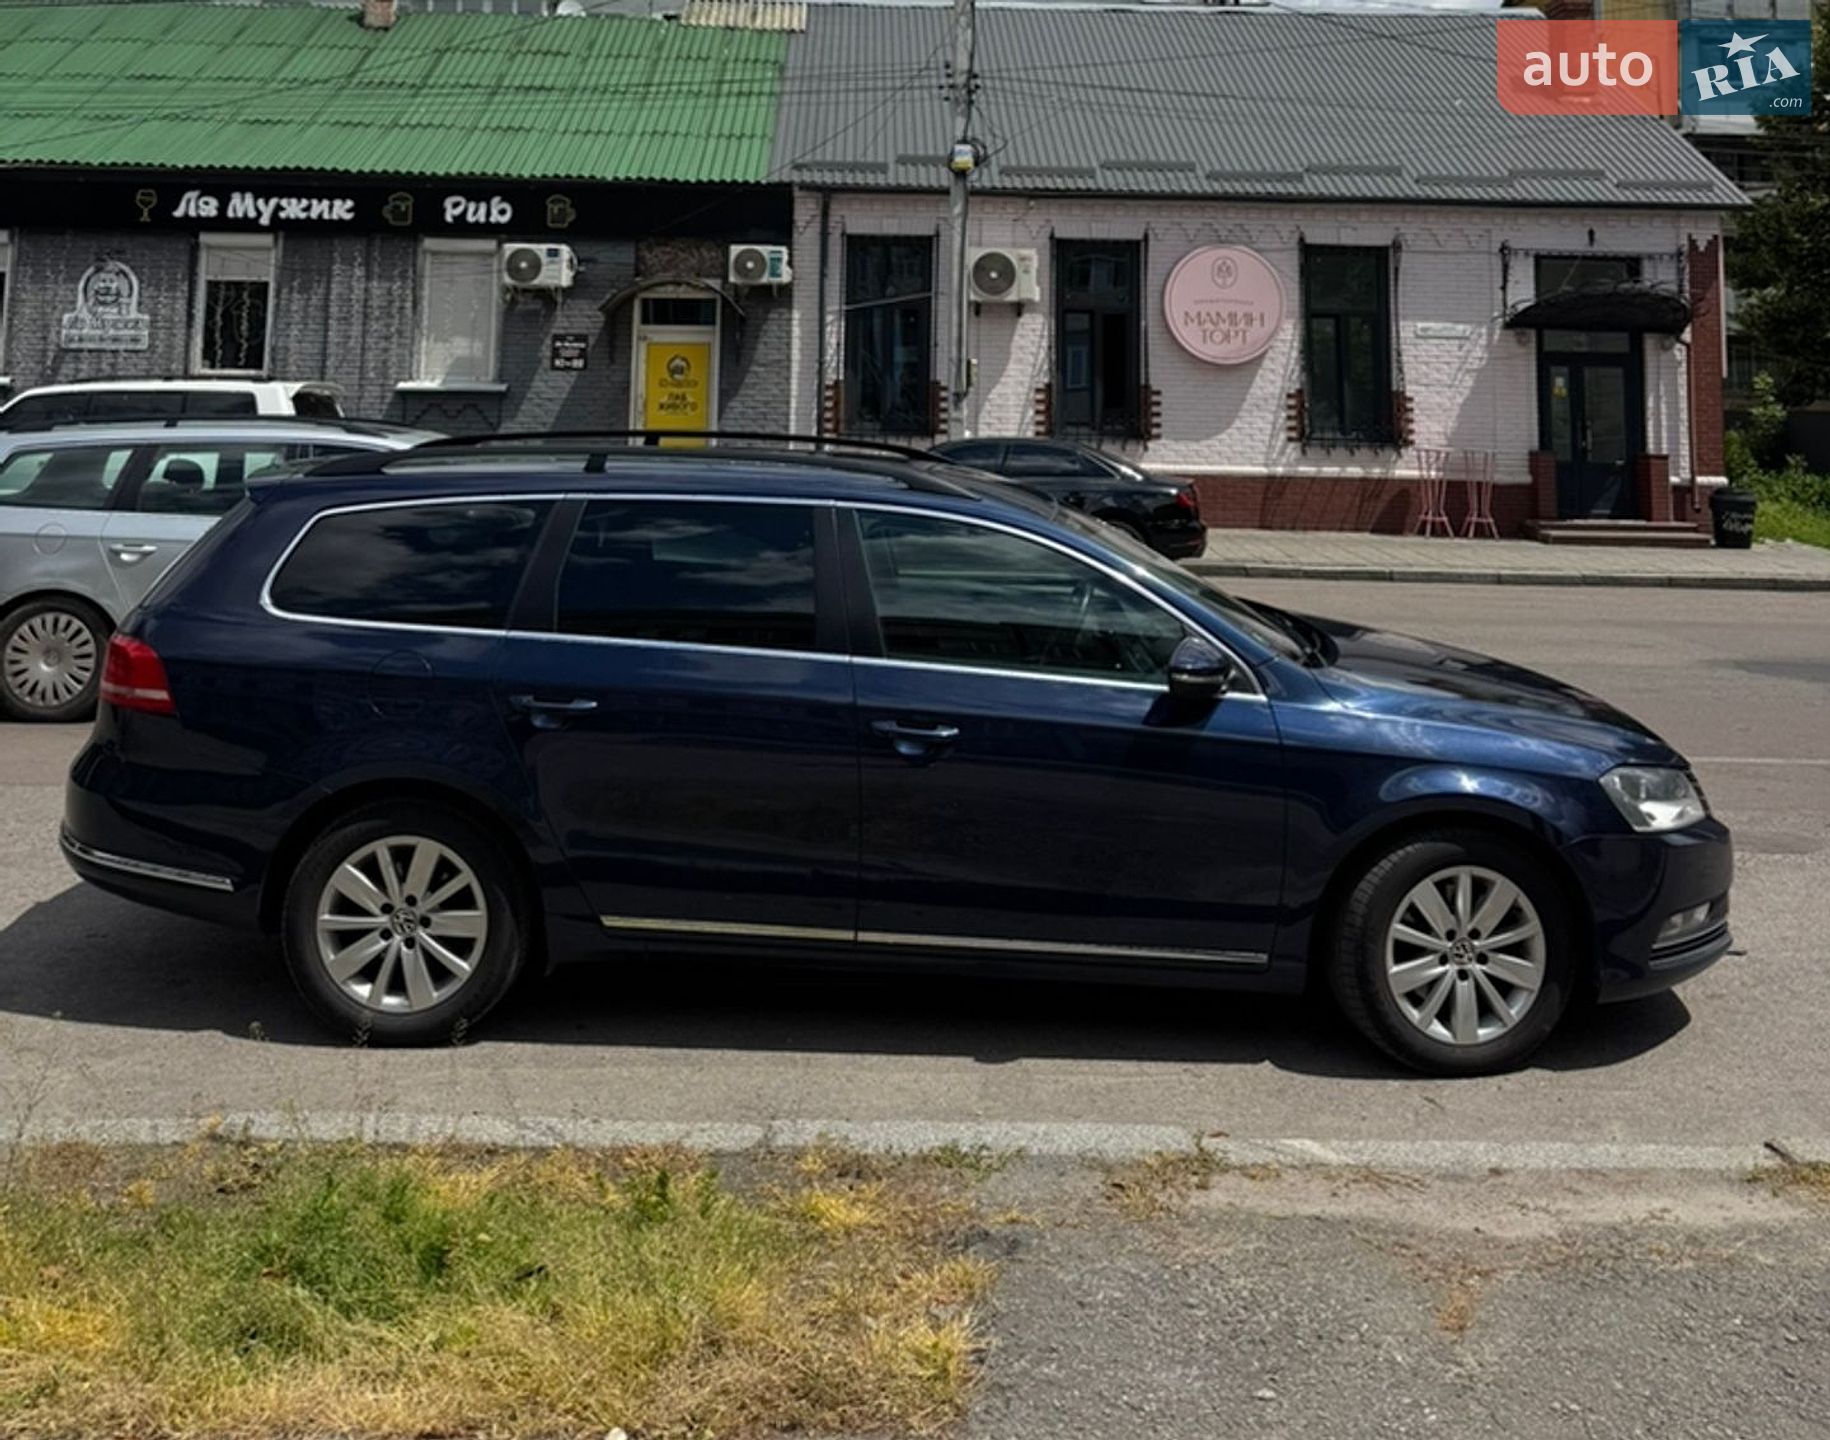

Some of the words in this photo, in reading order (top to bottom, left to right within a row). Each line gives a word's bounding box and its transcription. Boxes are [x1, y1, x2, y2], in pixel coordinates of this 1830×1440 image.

[226, 191, 355, 226] Мужик
[443, 195, 513, 224] Pub
[1184, 310, 1266, 328] МАМИН
[1201, 328, 1250, 346] ТОРТ
